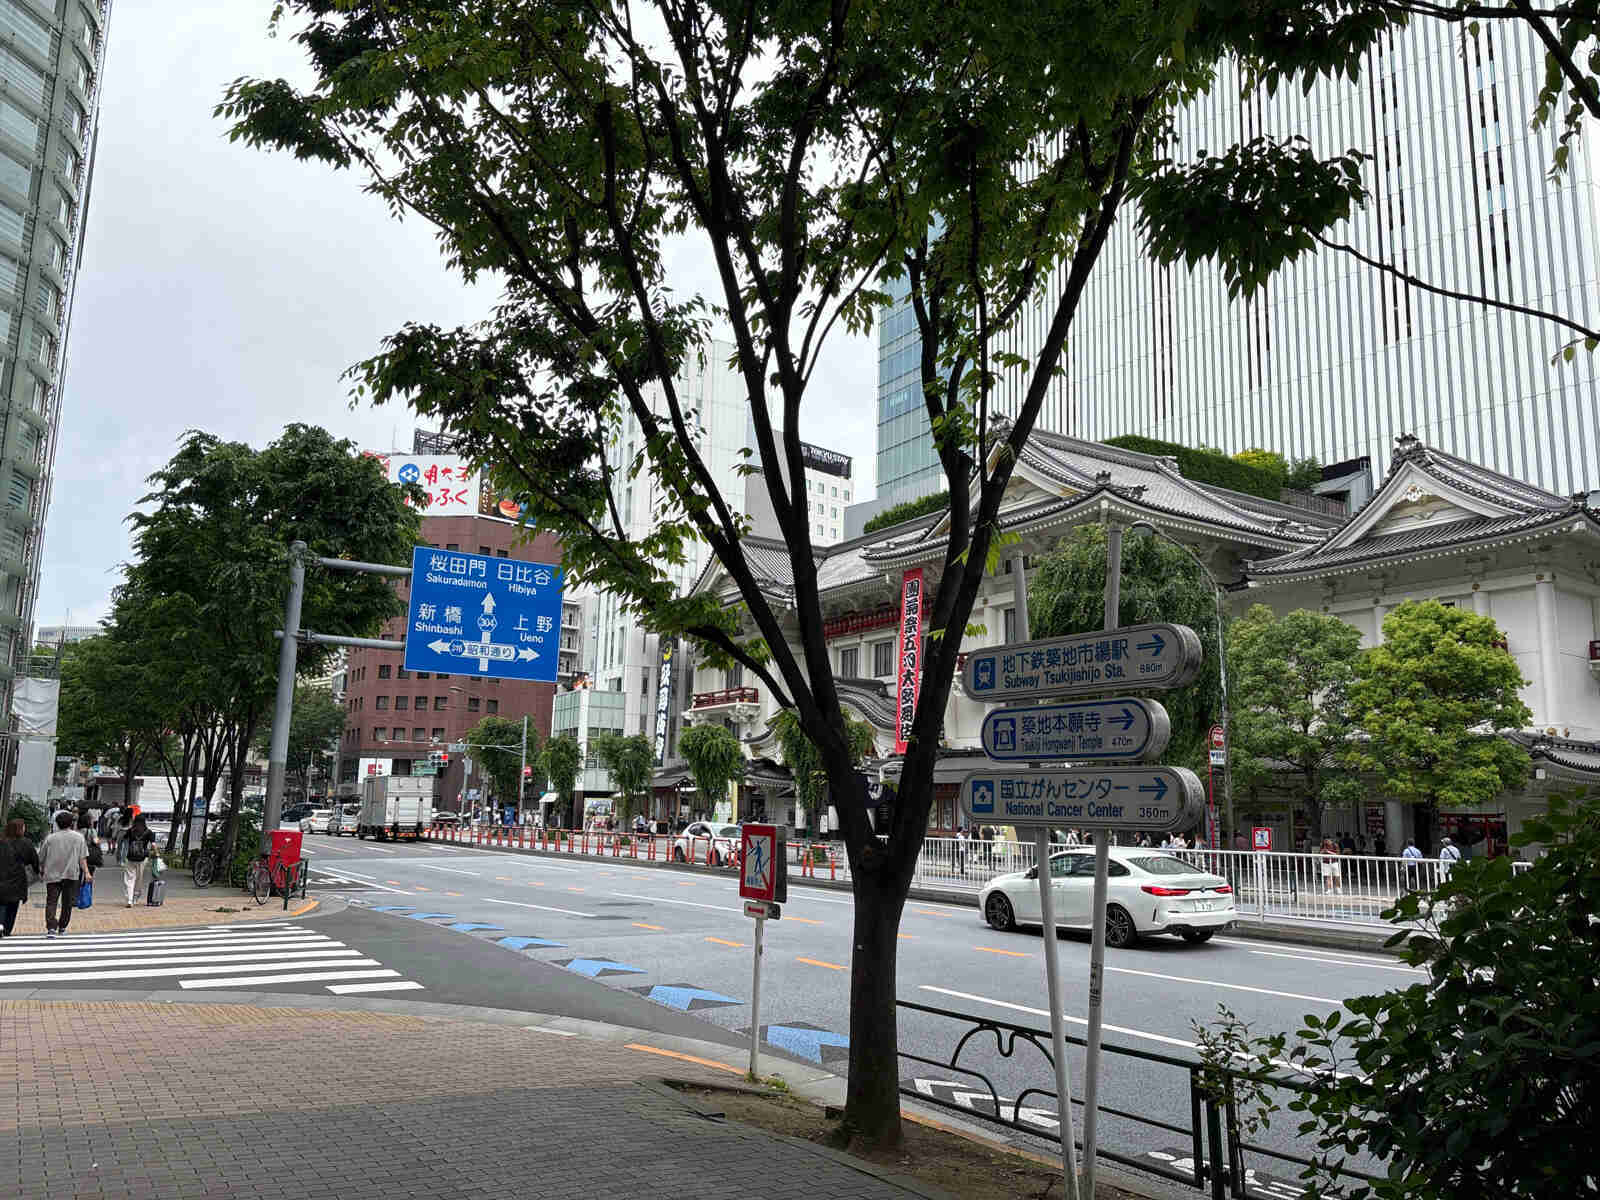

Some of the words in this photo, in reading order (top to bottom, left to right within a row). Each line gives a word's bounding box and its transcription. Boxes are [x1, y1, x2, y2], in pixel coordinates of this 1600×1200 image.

[431, 553, 487, 577] 桜田門
[497, 563, 551, 586] 日比谷
[426, 572, 488, 589] Sakuradamon
[508, 583, 537, 597] Hibiya
[418, 603, 462, 624] 新橋
[480, 617, 494, 628] 304
[415, 621, 464, 636] Shinbashi
[513, 614, 552, 633] 上野
[520, 632, 544, 644] Ueno
[466, 643, 512, 658] 昭和通り
[1002, 638, 1130, 675] 地下鉄築地市場駅
[1004, 674, 1040, 689] Subway
[1044, 668, 1101, 685] Tsukijishijo
[1104, 663, 1126, 679] Sta.
[1021, 711, 1102, 736] 築地本願寺
[1000, 778, 1129, 800] 国立がんセンター
[1005, 802, 1043, 817] National
[1047, 802, 1083, 818] Cancer
[1087, 802, 1124, 818] Center
